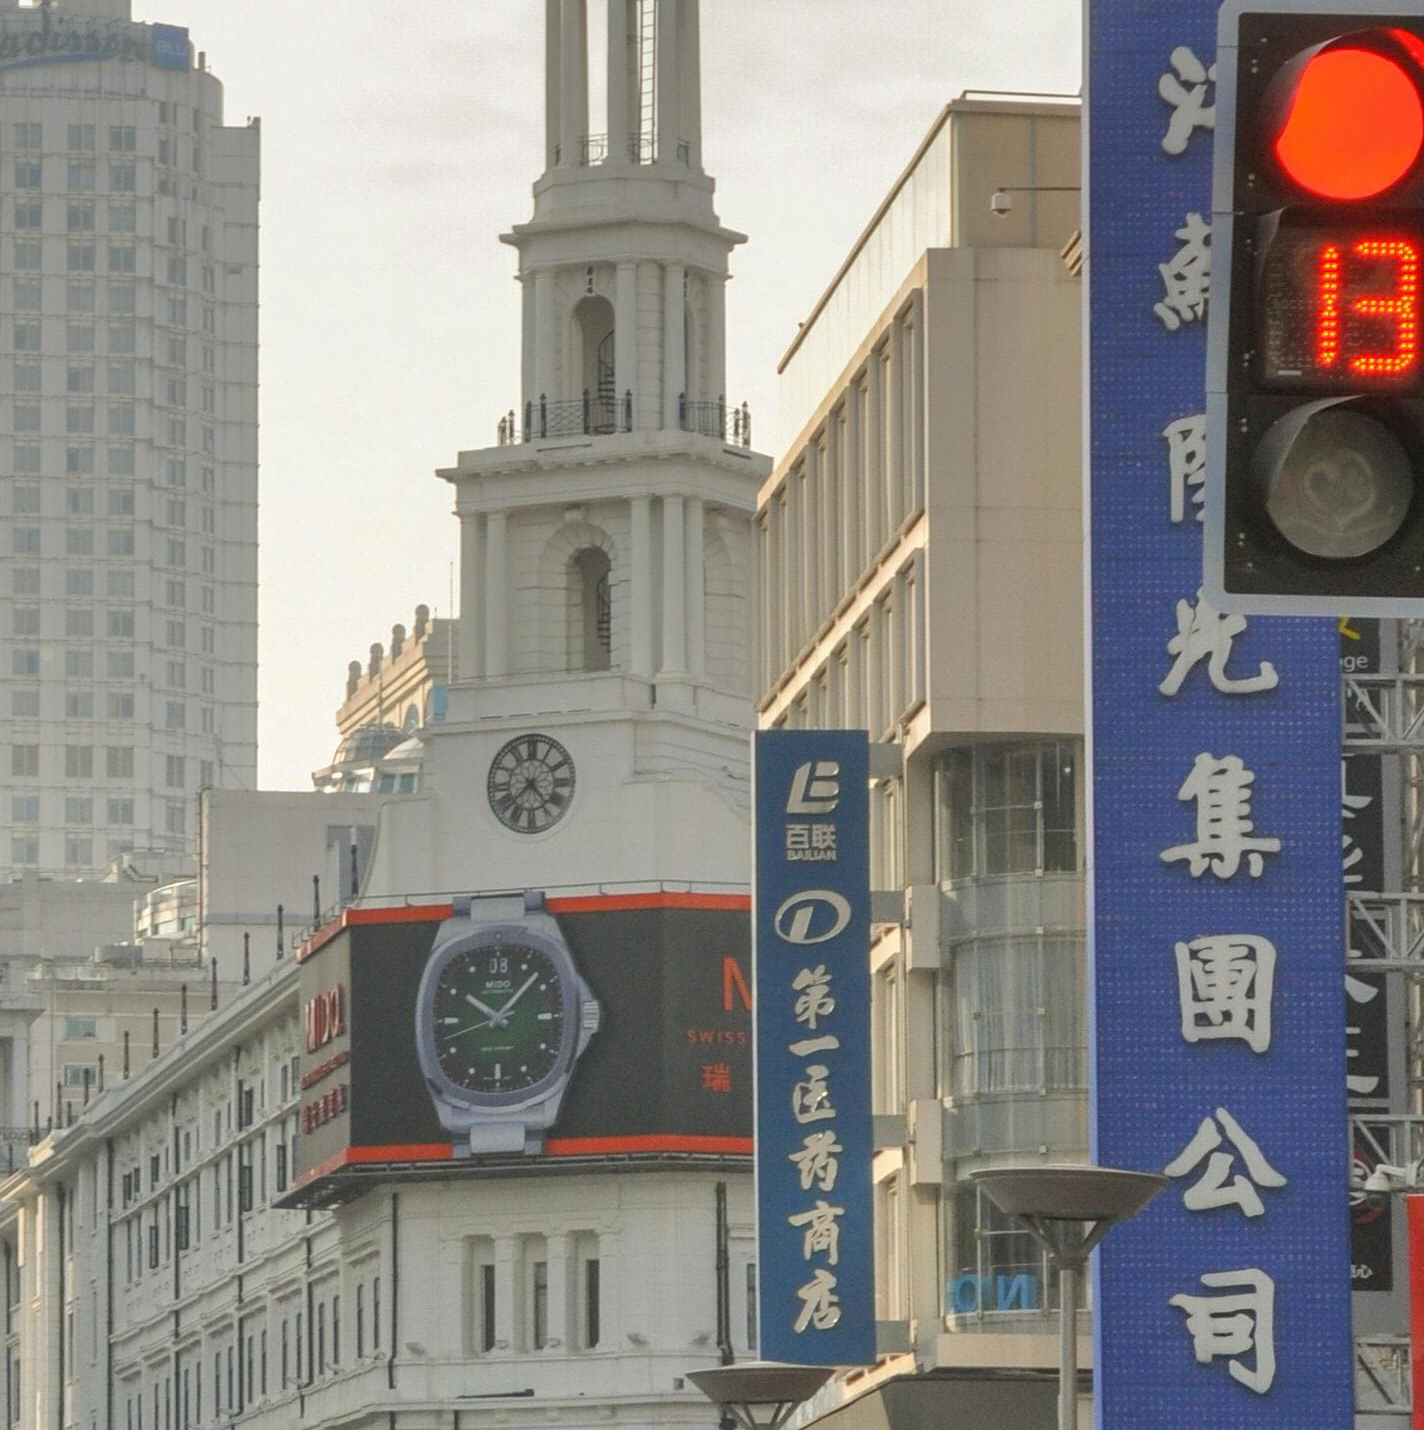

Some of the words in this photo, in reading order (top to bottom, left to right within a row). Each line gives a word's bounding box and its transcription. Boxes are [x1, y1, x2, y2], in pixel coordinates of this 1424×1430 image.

[1318, 240, 1418, 375] 13
[786, 824, 837, 849] 百联
[787, 850, 837, 861] BAILIAN
[687, 1030, 747, 1045] SWISS
[788, 964, 845, 1333] 第一医药商店
